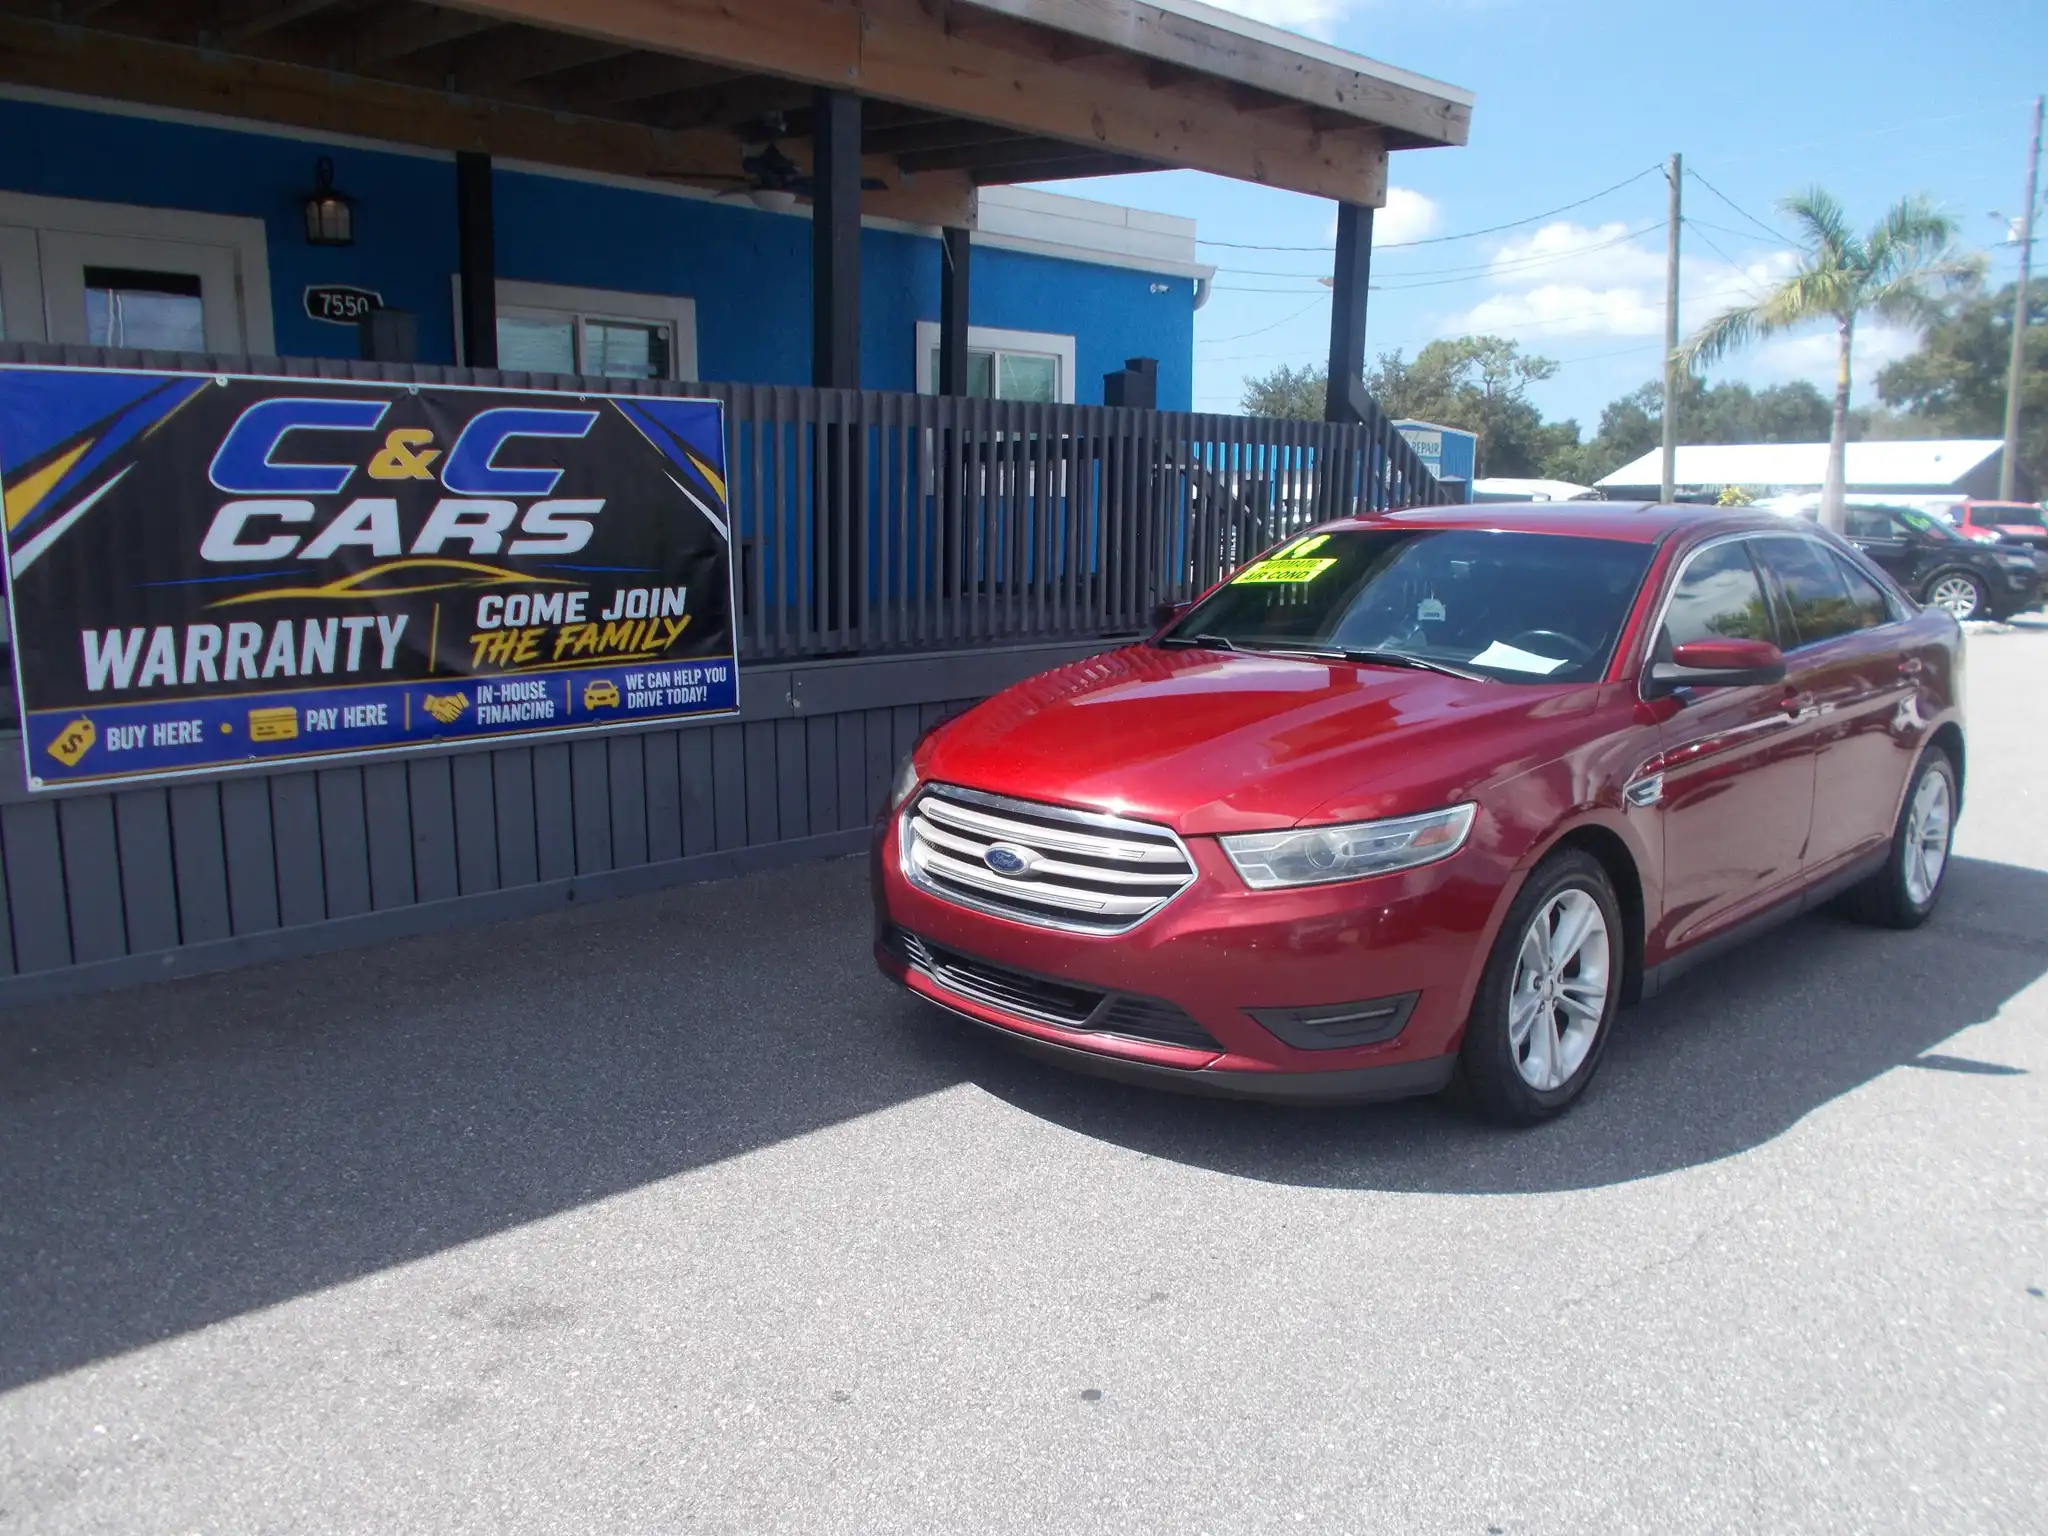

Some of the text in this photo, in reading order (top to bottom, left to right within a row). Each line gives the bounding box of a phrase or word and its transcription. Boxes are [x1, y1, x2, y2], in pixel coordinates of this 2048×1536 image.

[319, 293, 369, 316] 7550
[207, 397, 601, 496] C&C
[199, 498, 607, 562] CARS
[476, 586, 687, 630] COME JOIN
[81, 614, 410, 692] WARRANTY
[469, 614, 693, 670] THE FAMILY
[477, 680, 547, 704] IN-HOUSE
[625, 666, 728, 691] WE CAN HELP YOU
[627, 686, 708, 709] DRIVE TODAY!
[306, 703, 388, 732] PAY HERE
[477, 700, 555, 726] FINANCING
[106, 720, 204, 752] BUY HERE
